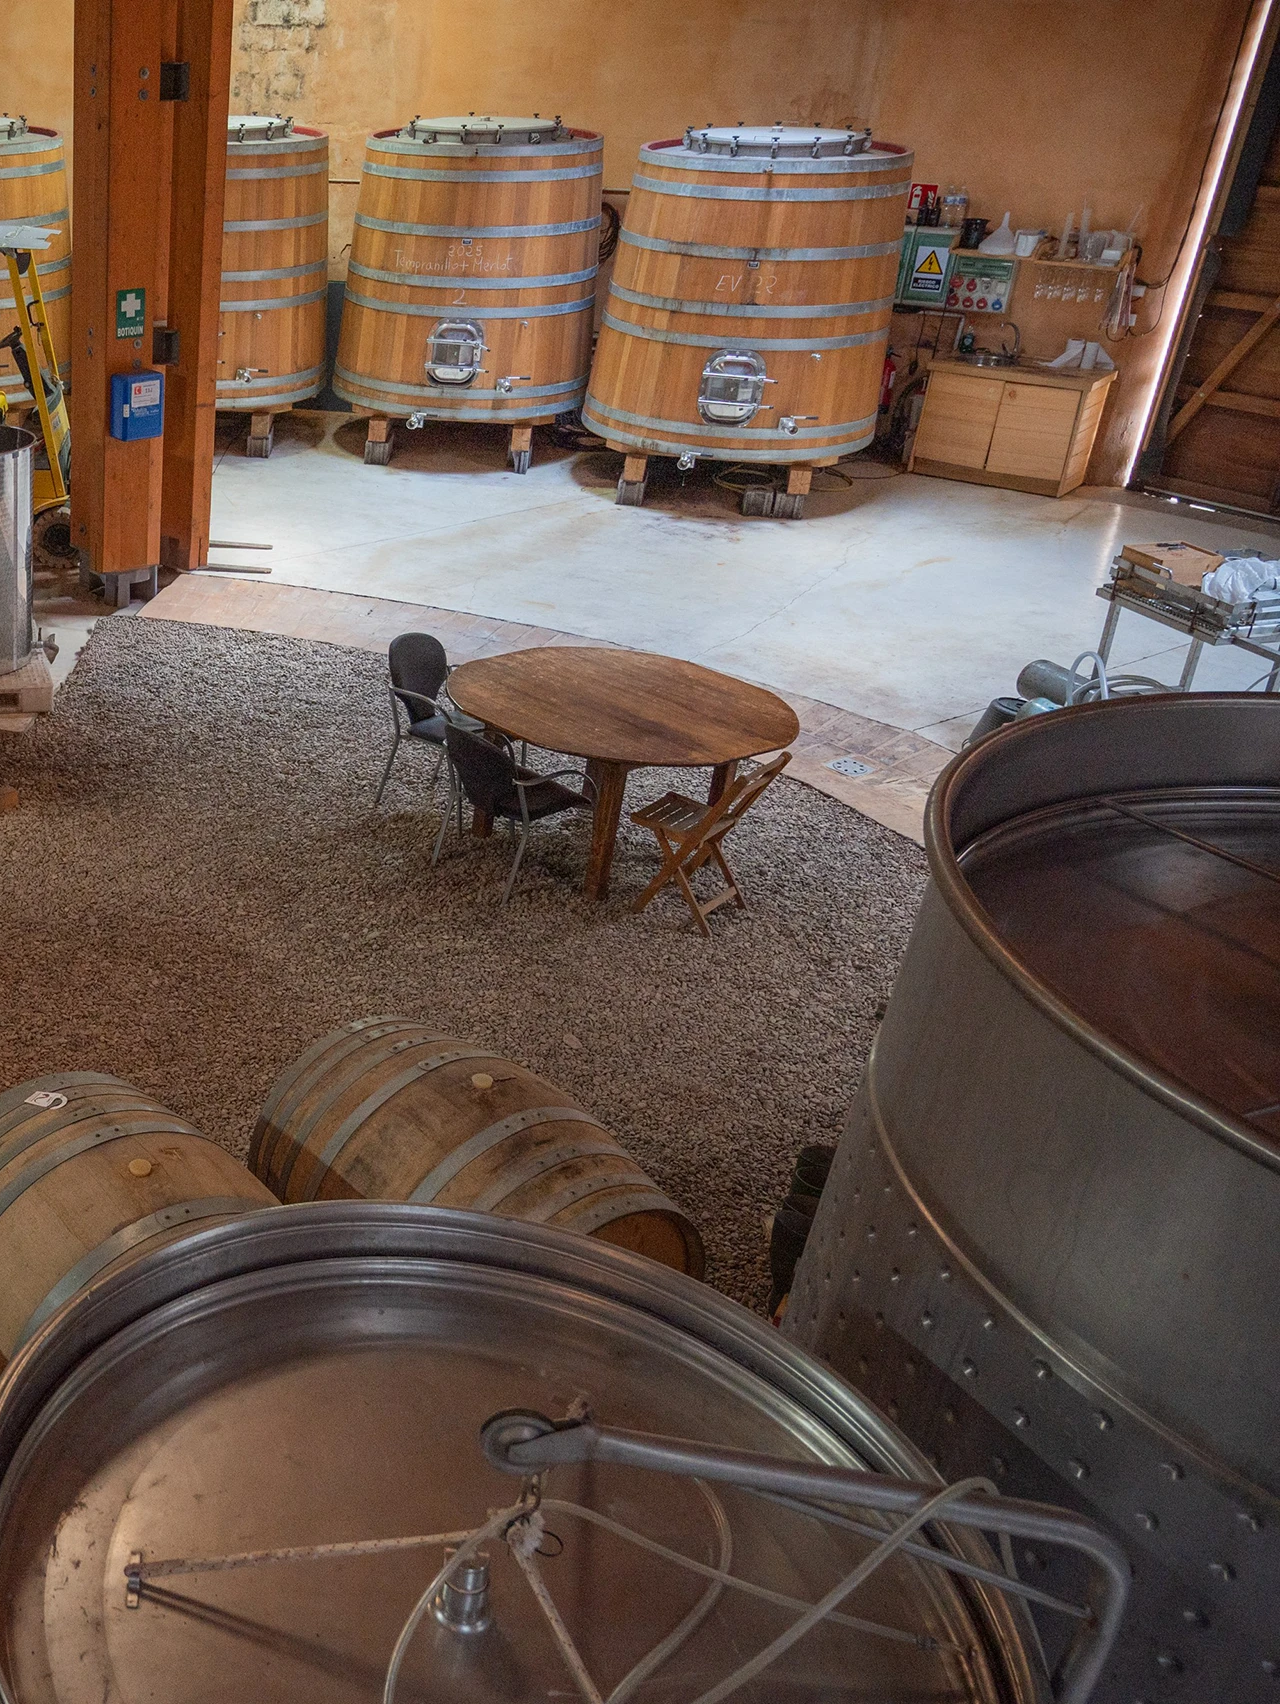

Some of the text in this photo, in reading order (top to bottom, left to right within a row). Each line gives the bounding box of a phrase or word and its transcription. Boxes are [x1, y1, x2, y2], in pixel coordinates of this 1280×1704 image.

[447, 245, 484, 257] 2025
[472, 253, 514, 272] Merlot
[715, 275, 743, 292] EV
[452, 288, 468, 305] 2
